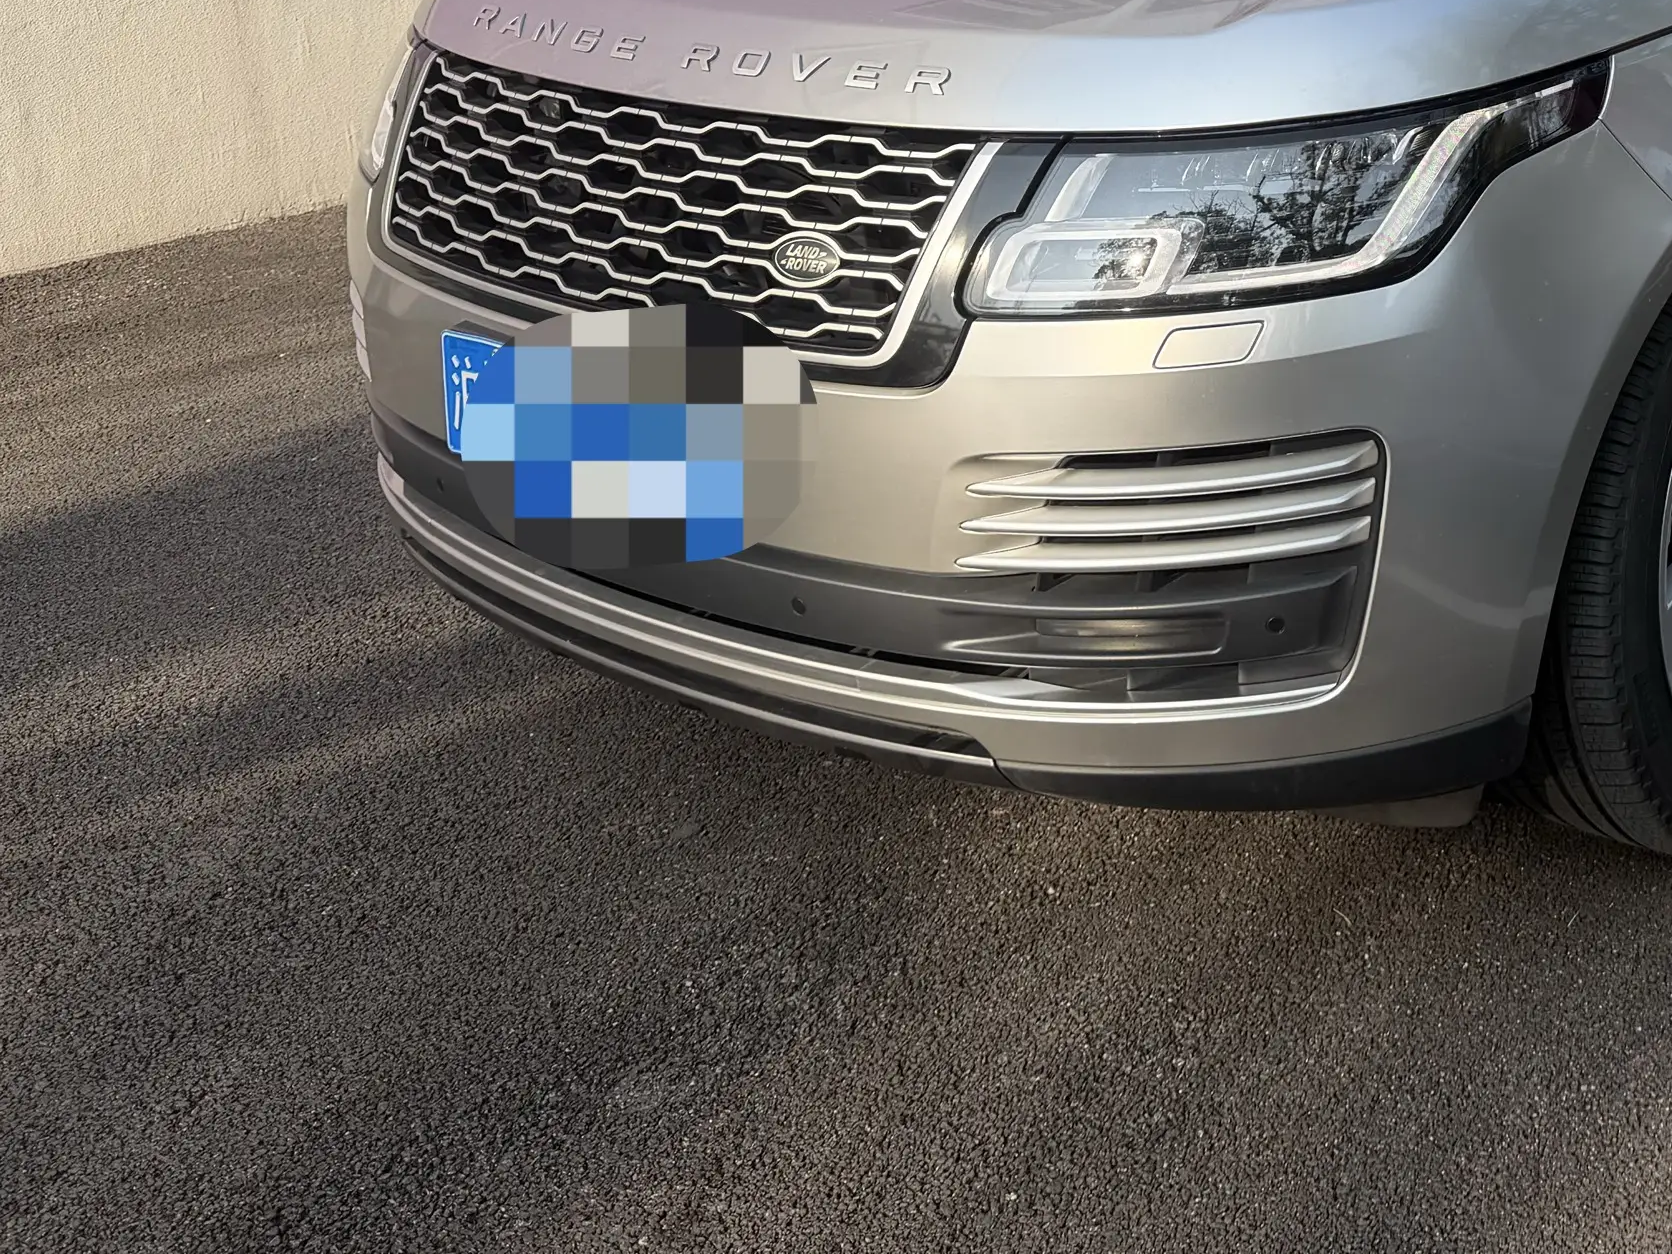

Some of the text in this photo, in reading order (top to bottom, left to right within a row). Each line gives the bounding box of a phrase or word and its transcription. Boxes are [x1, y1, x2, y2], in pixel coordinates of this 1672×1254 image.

[473, 6, 952, 96] RANGE ROVER
[786, 243, 820, 259] LAND
[785, 257, 827, 274] ROVER
